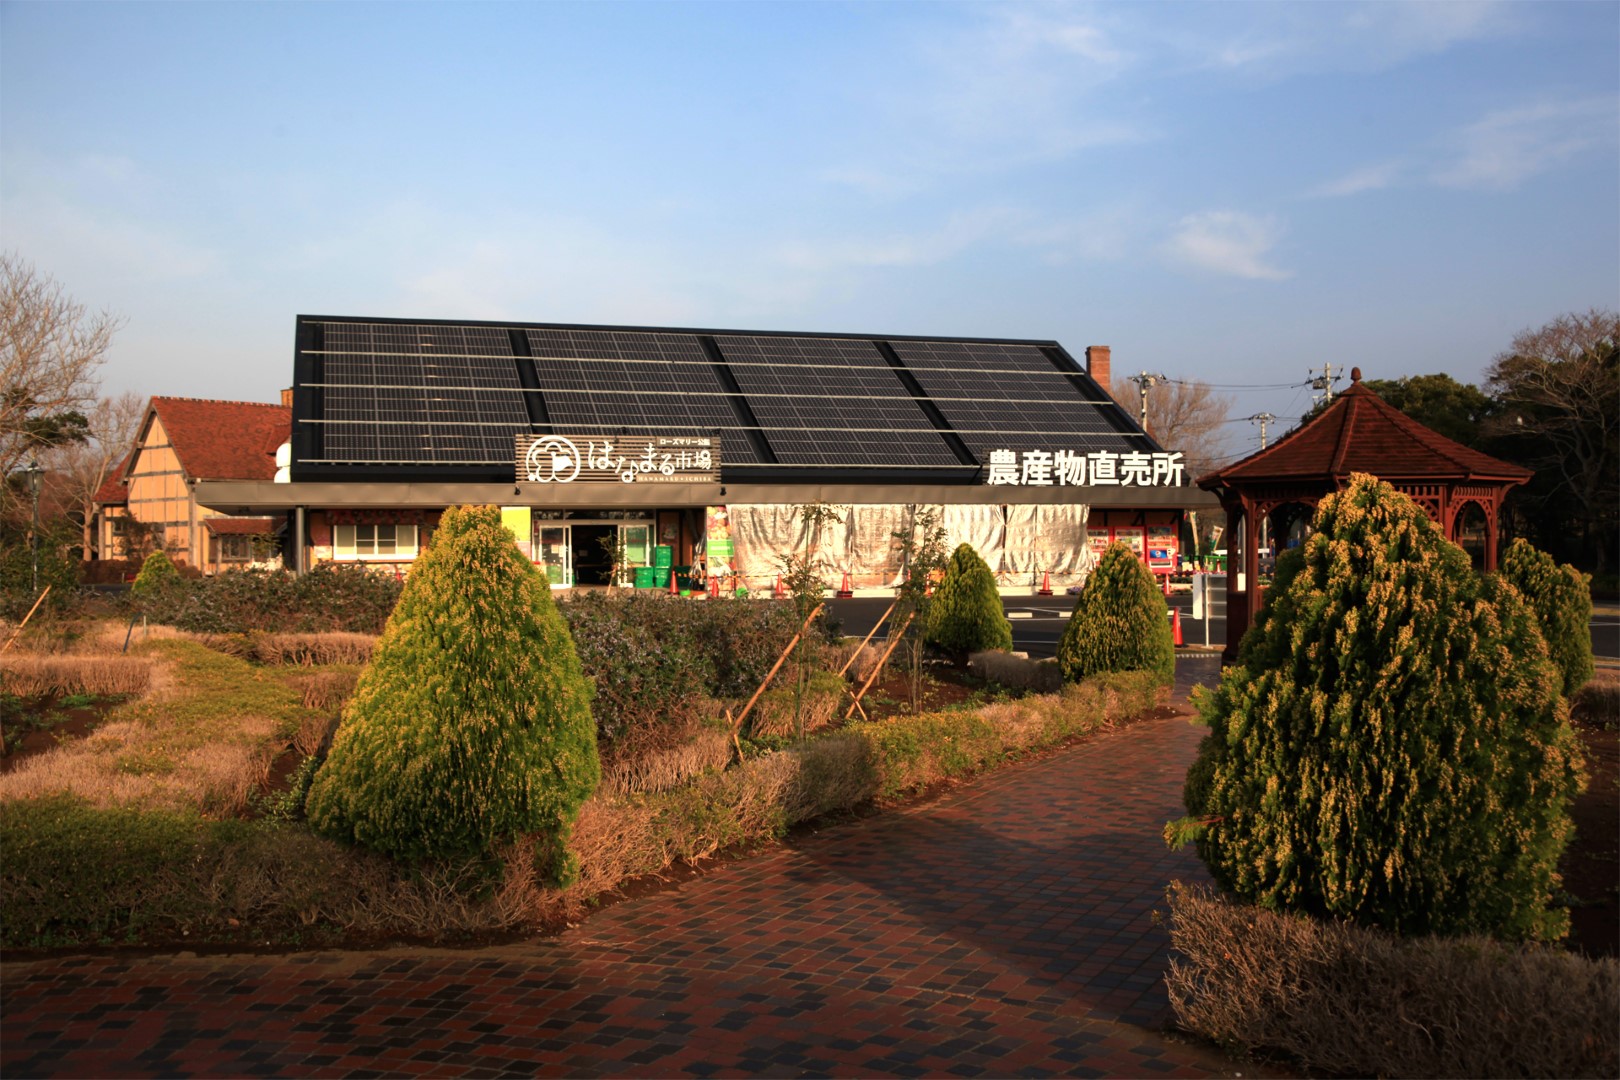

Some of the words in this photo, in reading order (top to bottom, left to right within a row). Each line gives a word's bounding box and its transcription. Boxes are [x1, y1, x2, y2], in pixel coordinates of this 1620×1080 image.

[987, 449, 1185, 487] 農産物直売所
